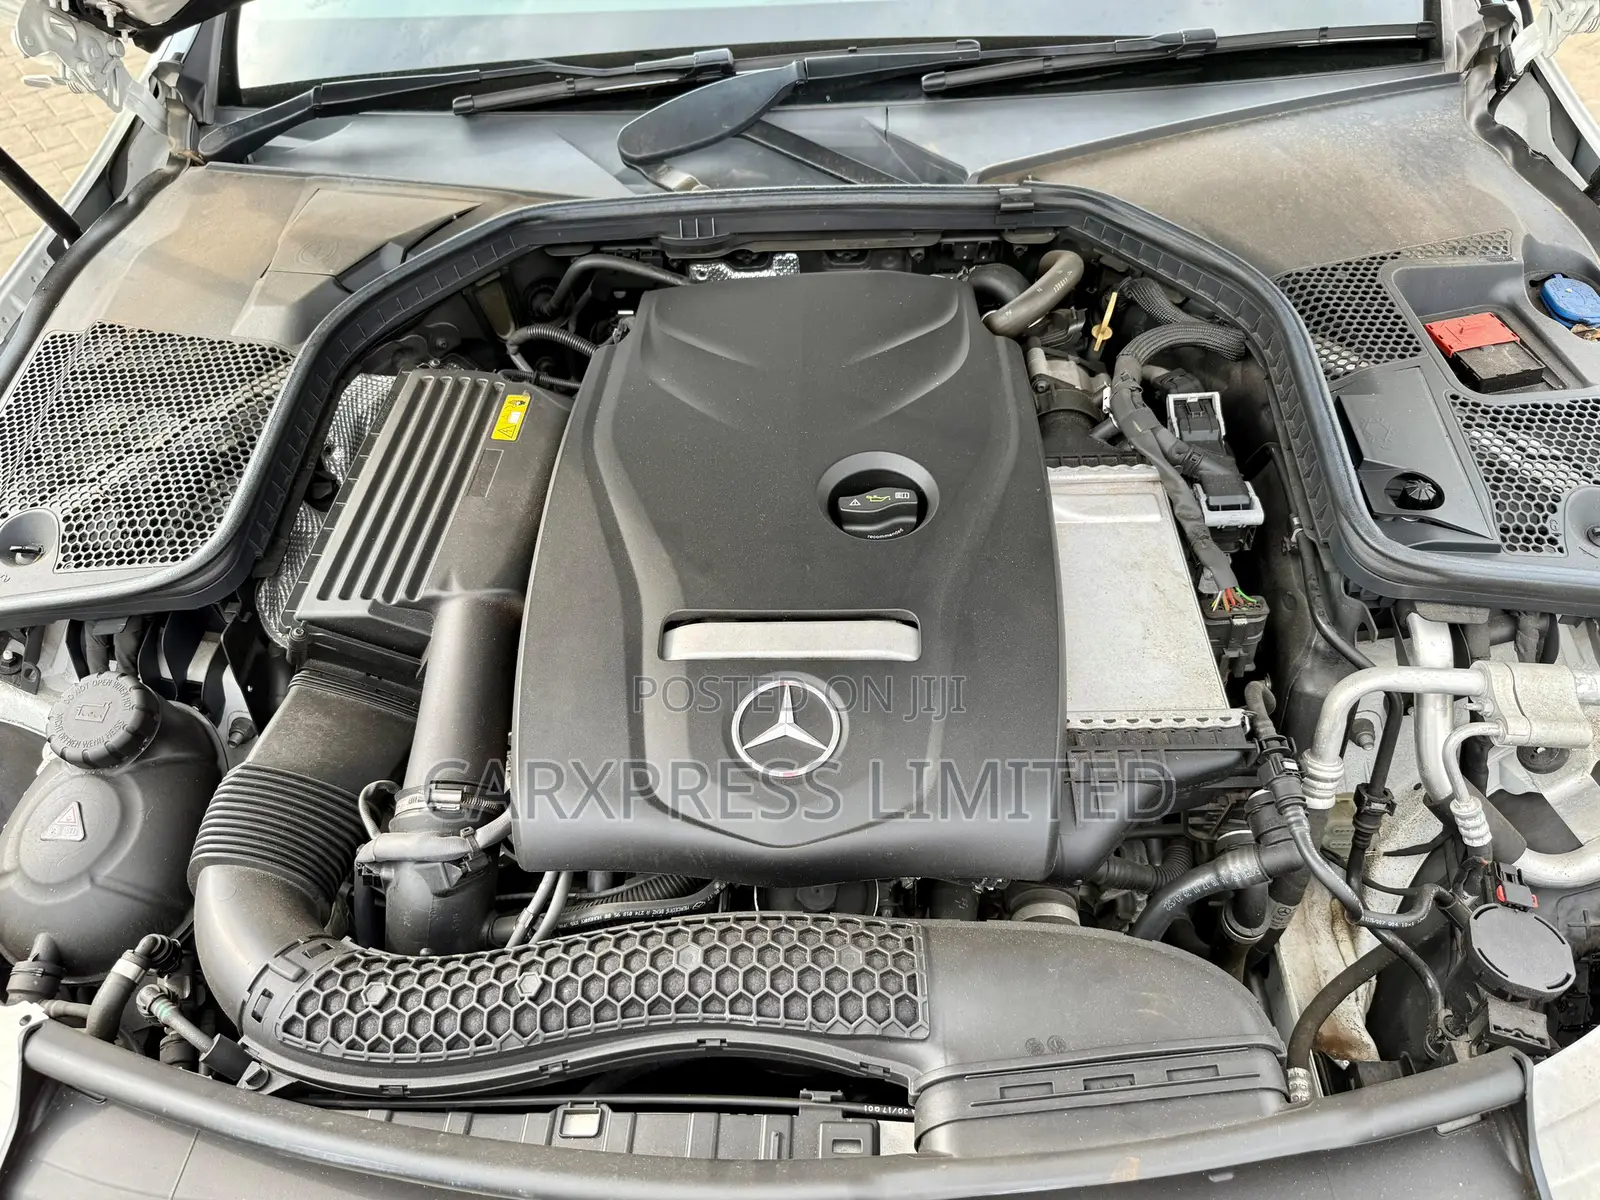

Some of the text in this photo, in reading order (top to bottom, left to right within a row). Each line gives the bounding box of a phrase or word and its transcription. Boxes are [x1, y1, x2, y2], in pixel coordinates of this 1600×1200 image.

[75, 682, 90, 696] NOT
[92, 679, 113, 688] OPEN
[112, 680, 130, 699] WHEN
[123, 697, 132, 712] HOT
[82, 736, 105, 749] WENN
